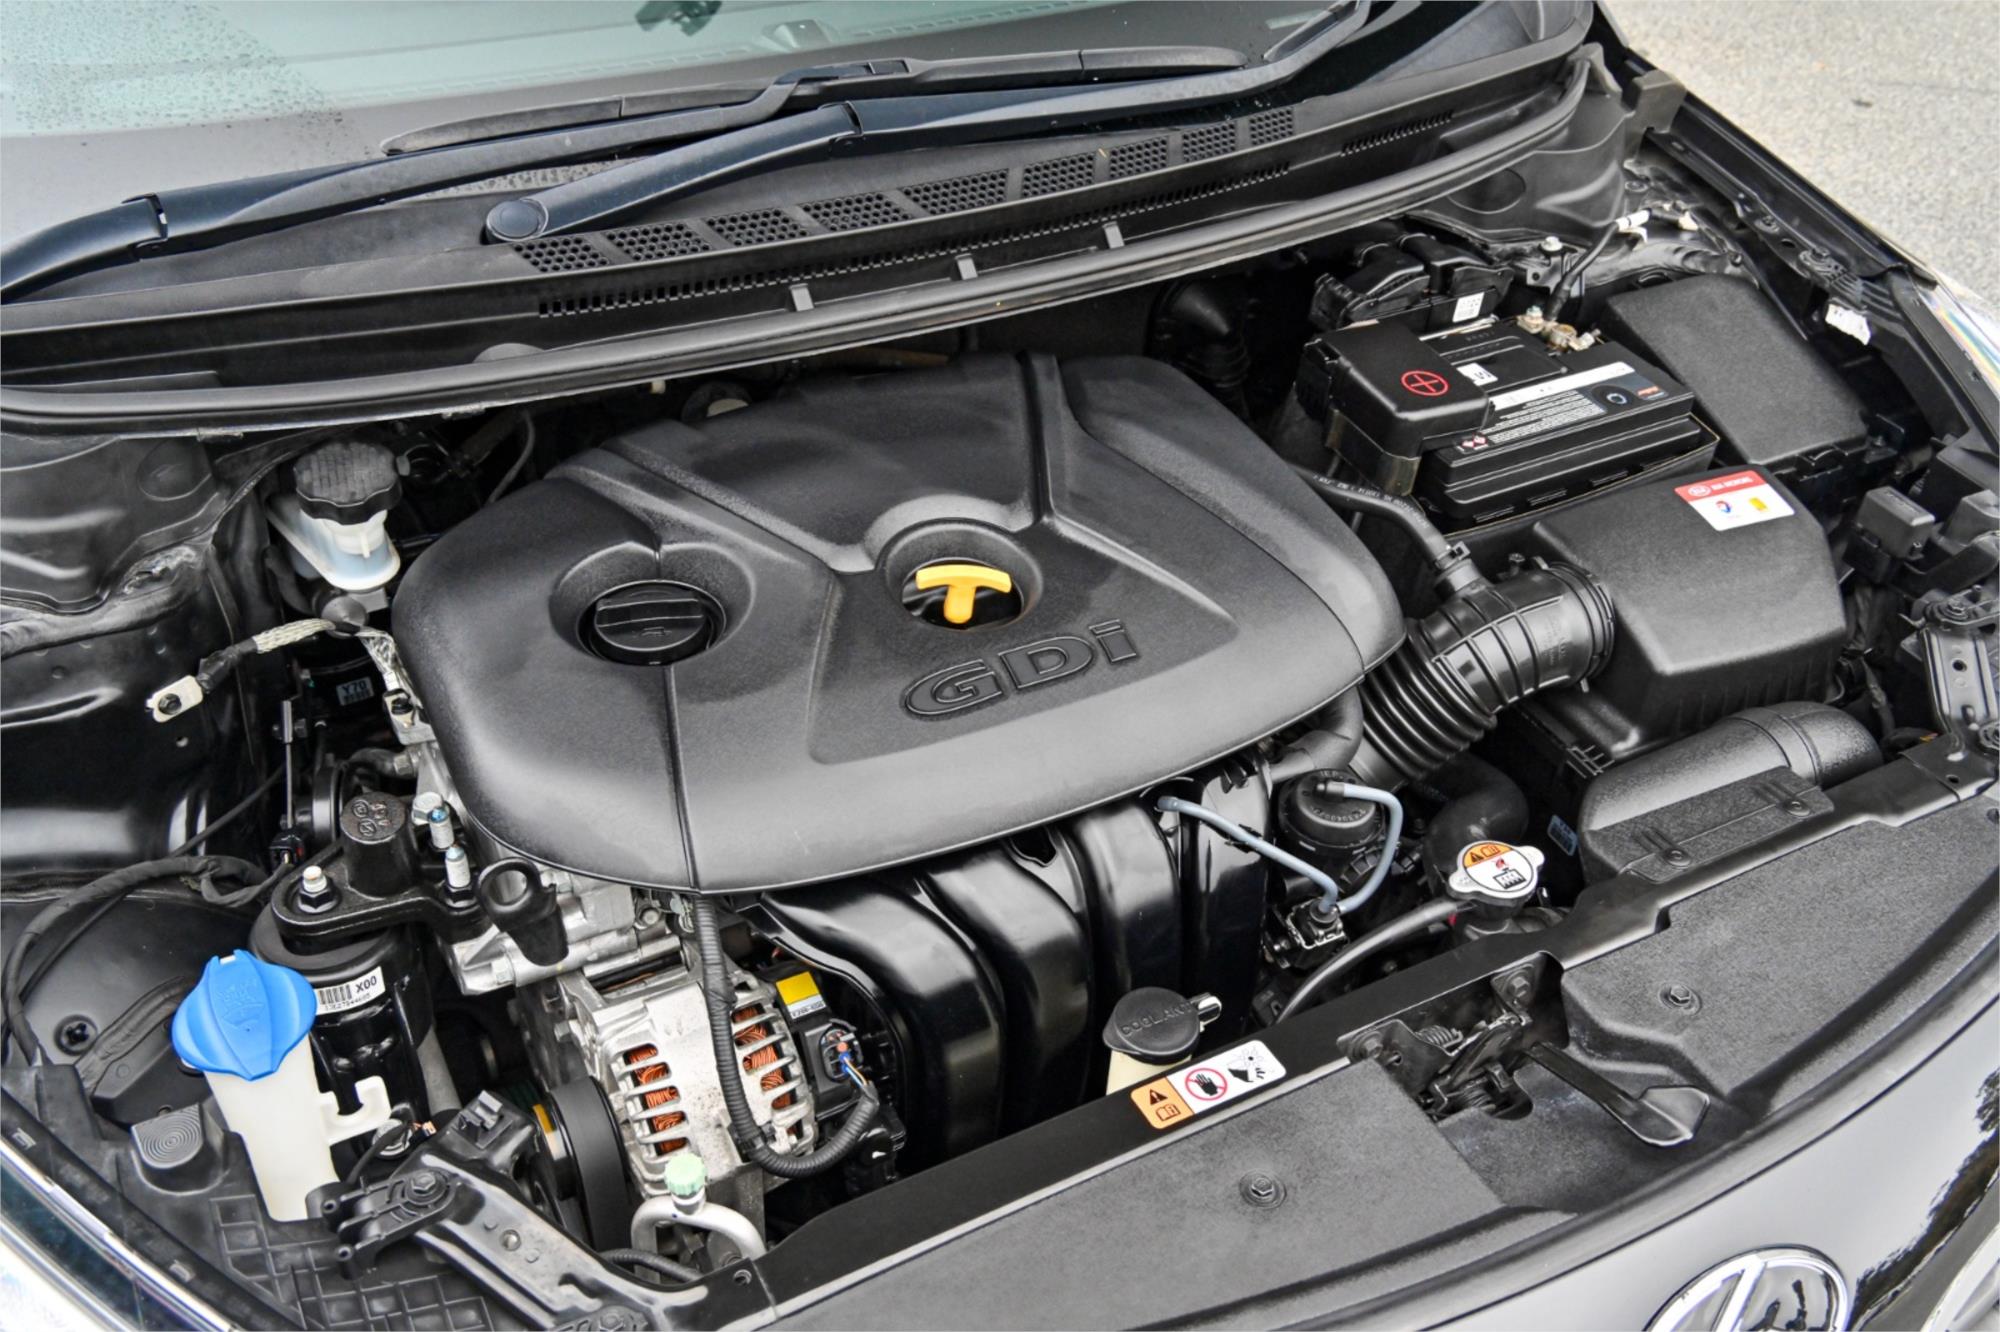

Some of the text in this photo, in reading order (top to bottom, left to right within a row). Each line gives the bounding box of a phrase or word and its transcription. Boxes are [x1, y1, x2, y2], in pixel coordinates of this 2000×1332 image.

[904, 619, 1138, 716] GDi
[355, 975, 377, 993] X00
[1121, 1002, 1192, 1037] COOLANT
